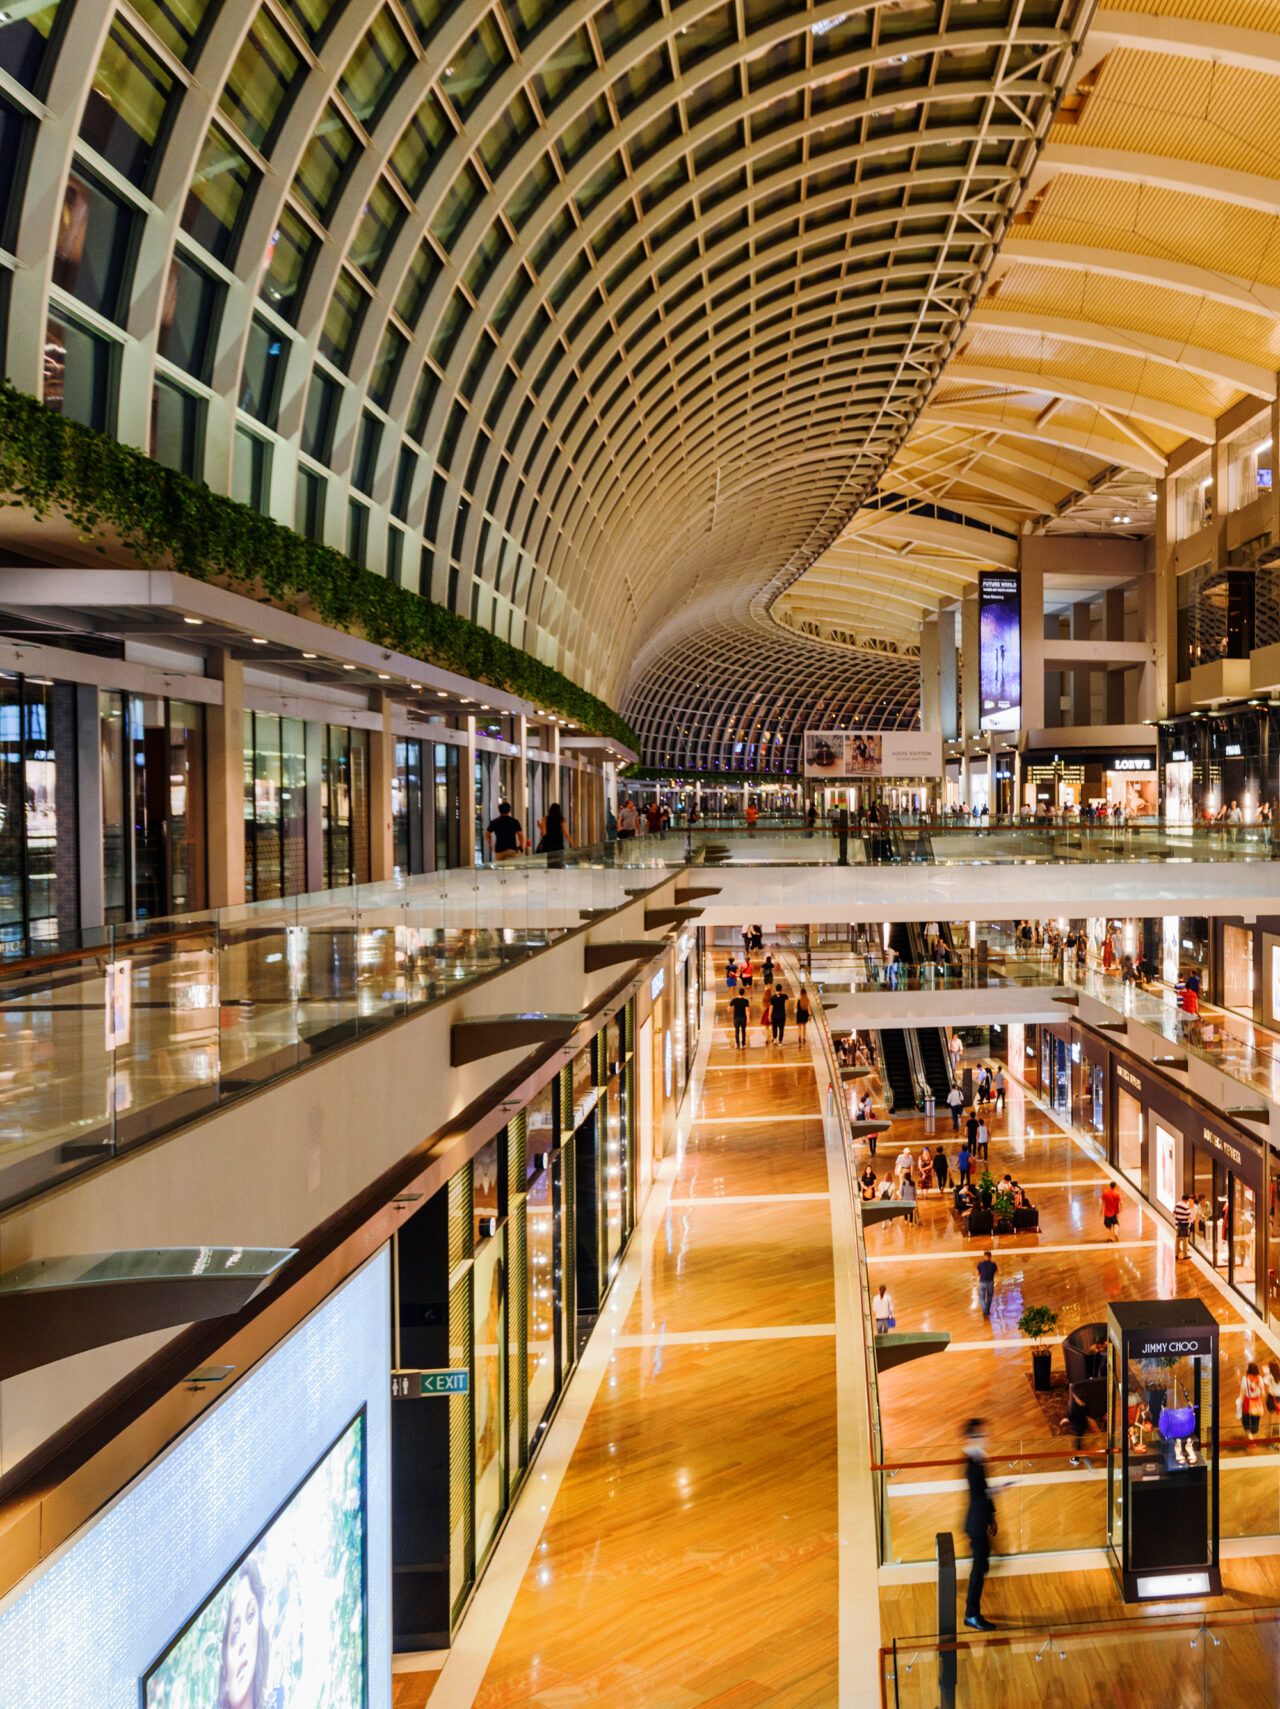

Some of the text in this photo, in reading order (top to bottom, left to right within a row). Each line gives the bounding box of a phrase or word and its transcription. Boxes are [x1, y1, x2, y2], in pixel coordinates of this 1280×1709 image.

[1114, 759, 1151, 770] LOEWE
[1142, 1341, 1199, 1354] JIMMY CHOO
[436, 1374, 466, 1391] EXIT
